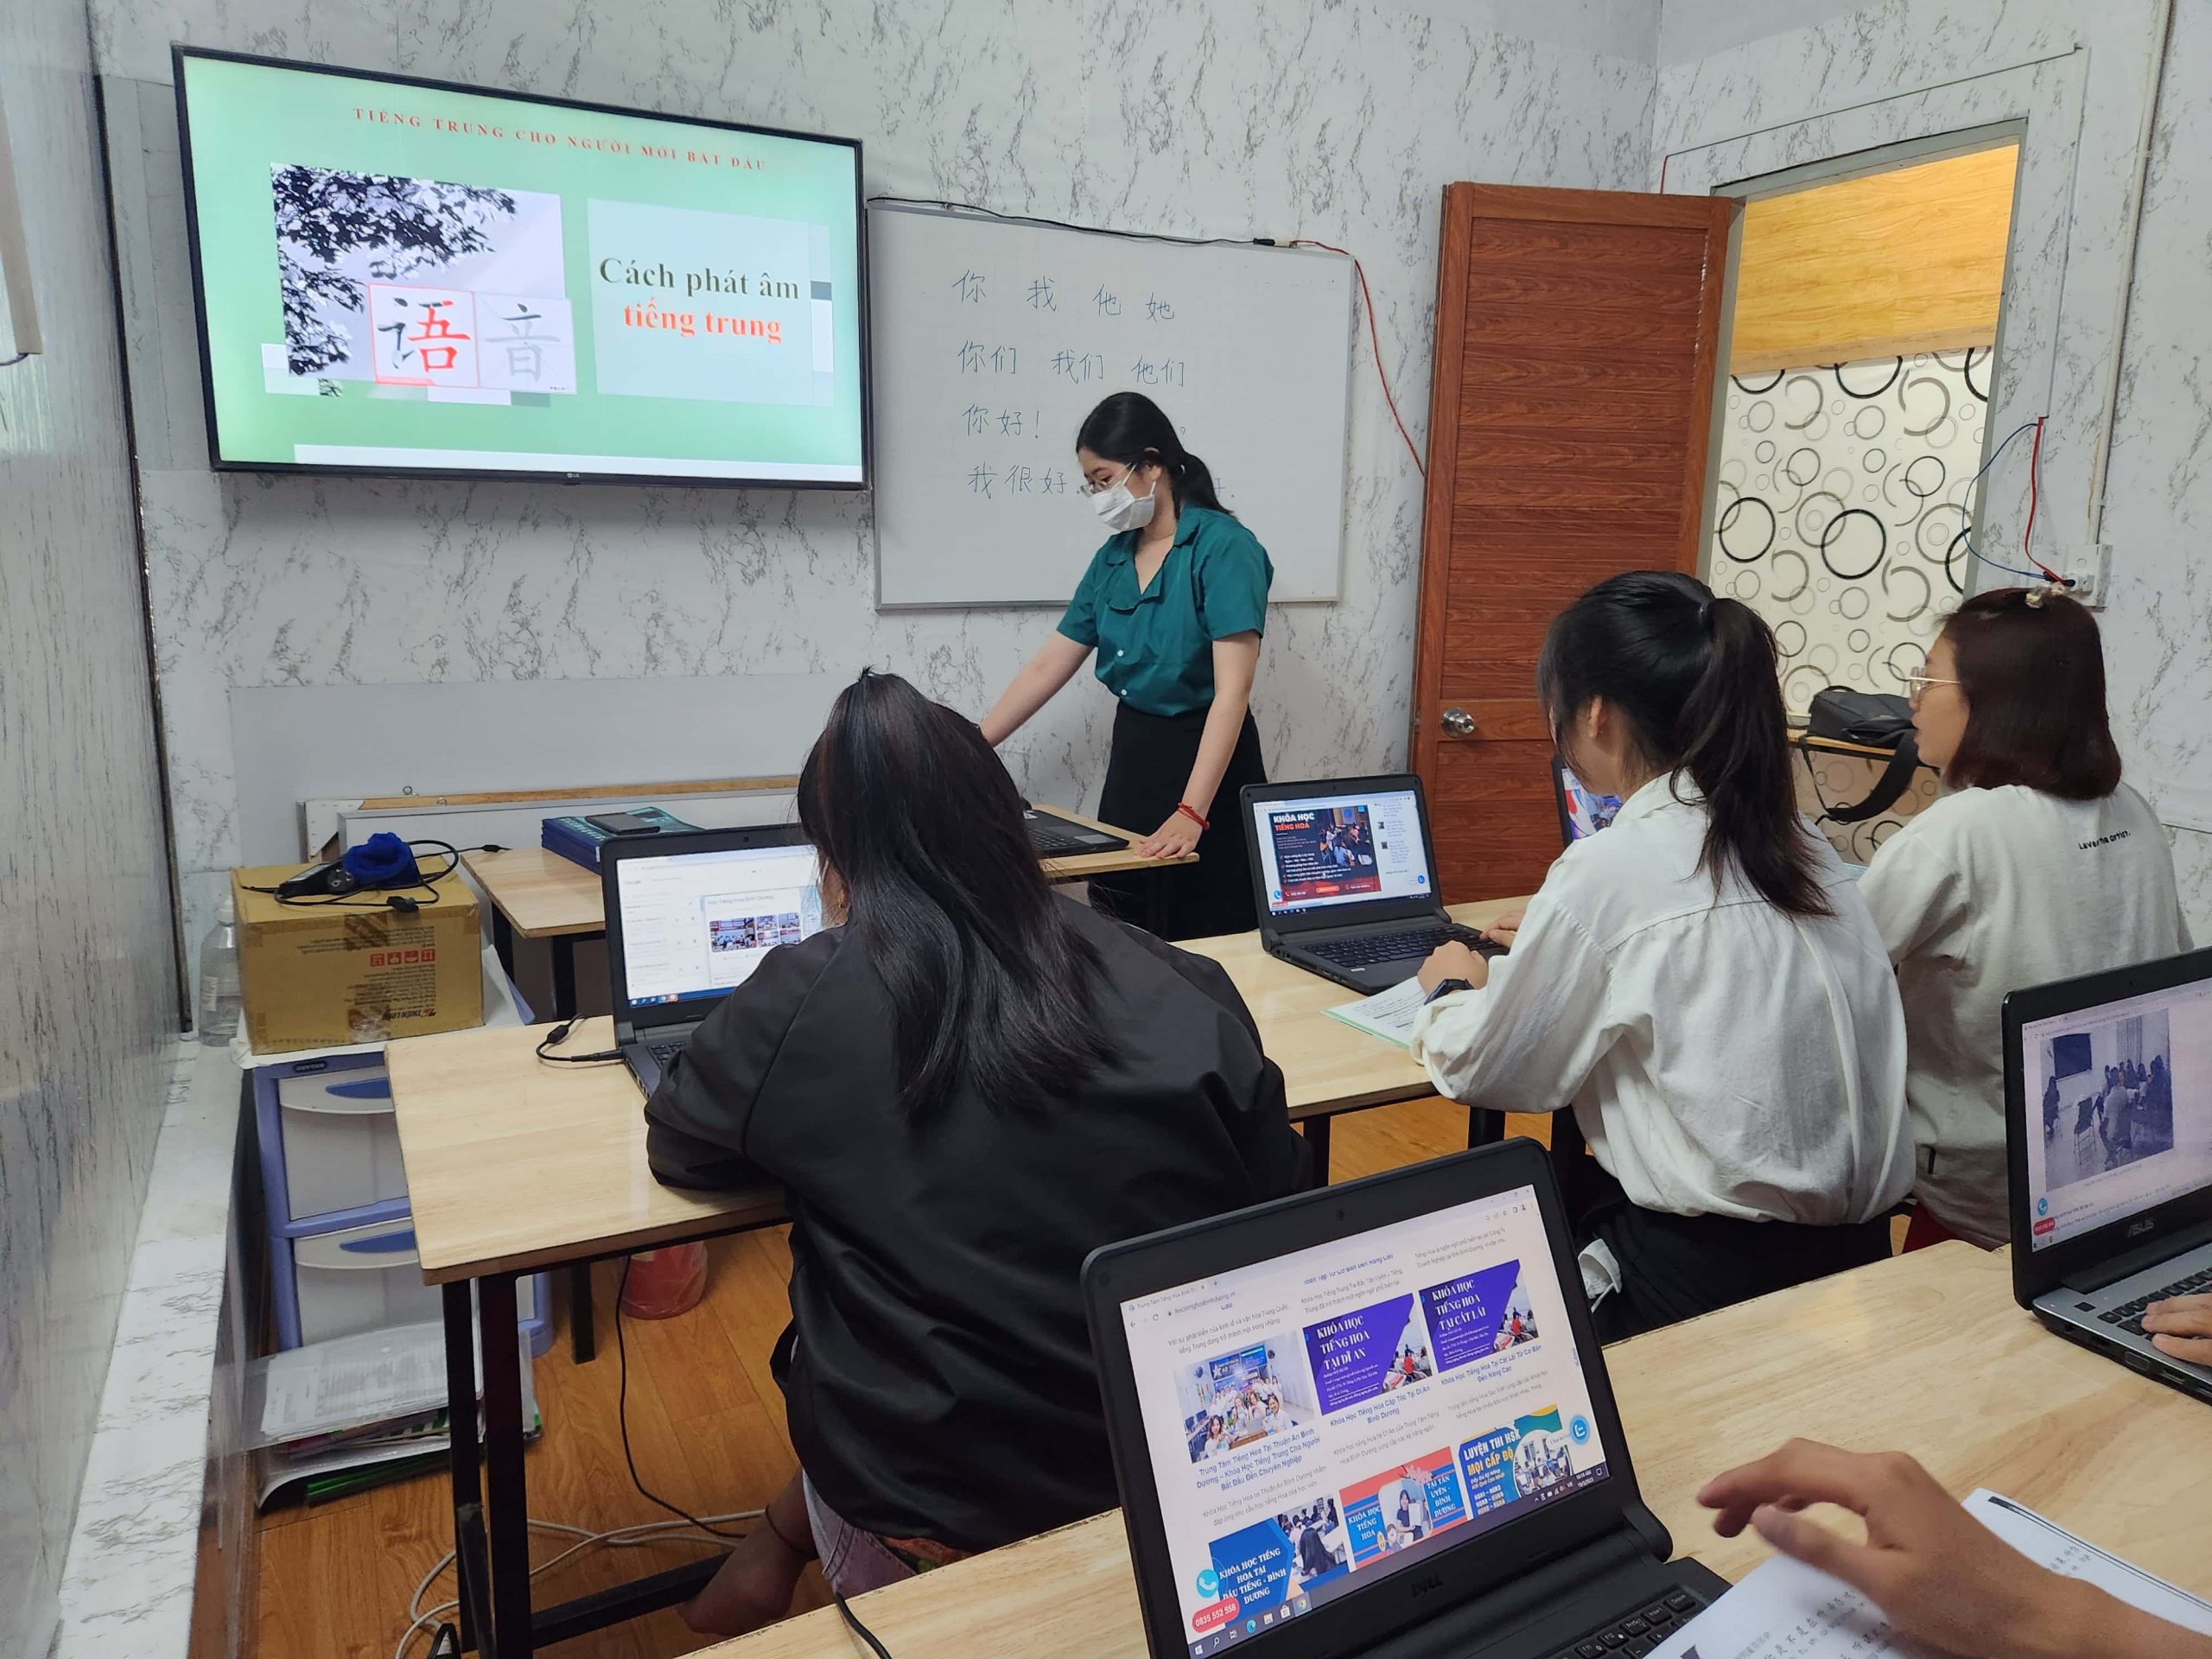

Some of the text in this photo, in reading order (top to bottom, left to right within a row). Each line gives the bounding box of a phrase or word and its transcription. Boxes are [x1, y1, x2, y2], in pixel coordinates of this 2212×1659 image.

[435, 118, 504, 138] TRUNG
[516, 130, 556, 145] CHO
[600, 257, 799, 299] Cách phát âm
[952, 269, 1175, 322] 你 我 他 她
[624, 296, 782, 344] tiếng trung
[957, 340, 1184, 387] 你们 我们 他们
[1432, 1280, 1475, 1300] KHÓA HỌC
[1434, 1294, 1480, 1314] TIẾNG HOA
[1317, 1315, 1365, 1338] KHÓA HỌC
[1439, 1318, 1455, 1332] TẠI
[1453, 1310, 1471, 1325] CÁT
[1319, 1330, 1370, 1354] TIẾNG HOA
[1324, 1357, 1341, 1371] TẠI
[1353, 1347, 1366, 1359] AN
[1463, 1429, 1521, 1461] LUYỆN THI HSK
[1467, 1446, 1515, 1477] MỌI CẤP ĐỘ
[1348, 1505, 1382, 1524] KHÓA HỌC
[1357, 1516, 1377, 1530] TIẾNG
[1361, 1528, 1376, 1540] HOA
[1219, 1546, 1281, 1579] KHÓA HỌC TIẾNG
[1236, 1566, 1266, 1583] HOA TẠI
[1239, 1578, 1262, 1593] TIẾNG
[1267, 1567, 1287, 1581] BÌNH
[1243, 1587, 1270, 1604] DƯƠNG
[1195, 1603, 1236, 1626] 0835 552 558
